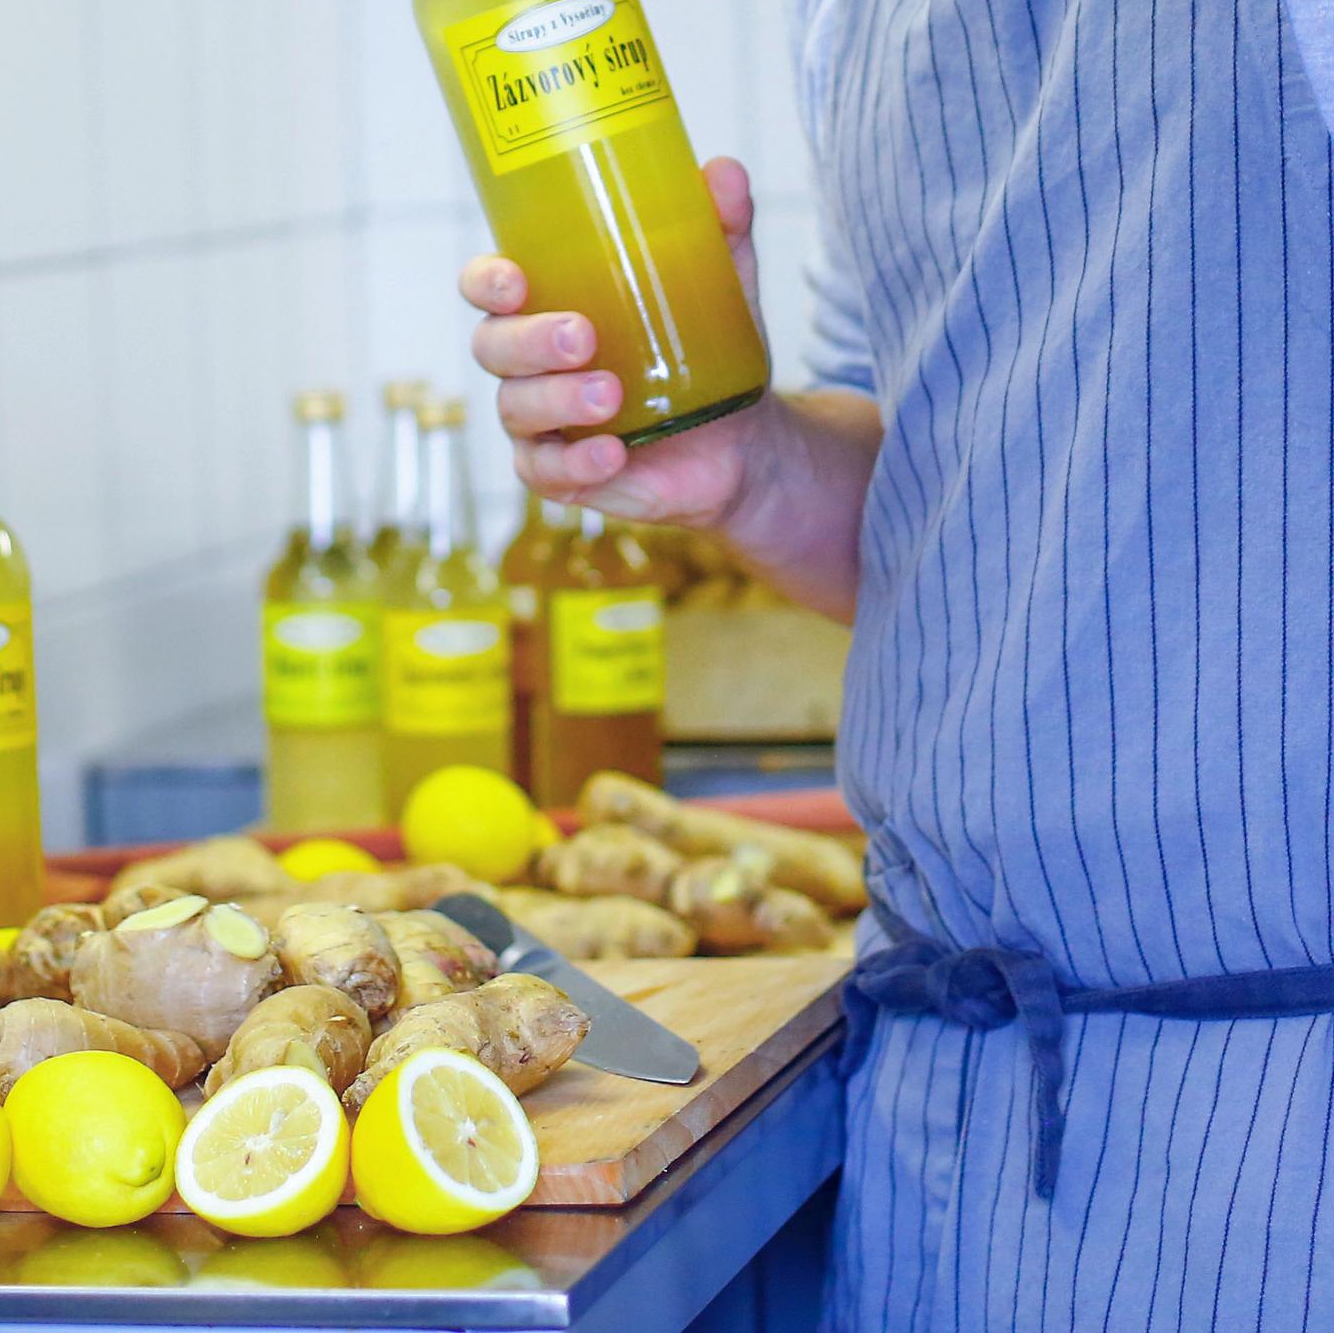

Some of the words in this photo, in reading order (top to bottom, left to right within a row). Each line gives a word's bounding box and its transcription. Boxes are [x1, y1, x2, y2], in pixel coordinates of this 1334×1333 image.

[508, 23, 547, 44] Sirupy
[487, 42, 599, 112] Zázvorový
[603, 35, 649, 72] sirup
